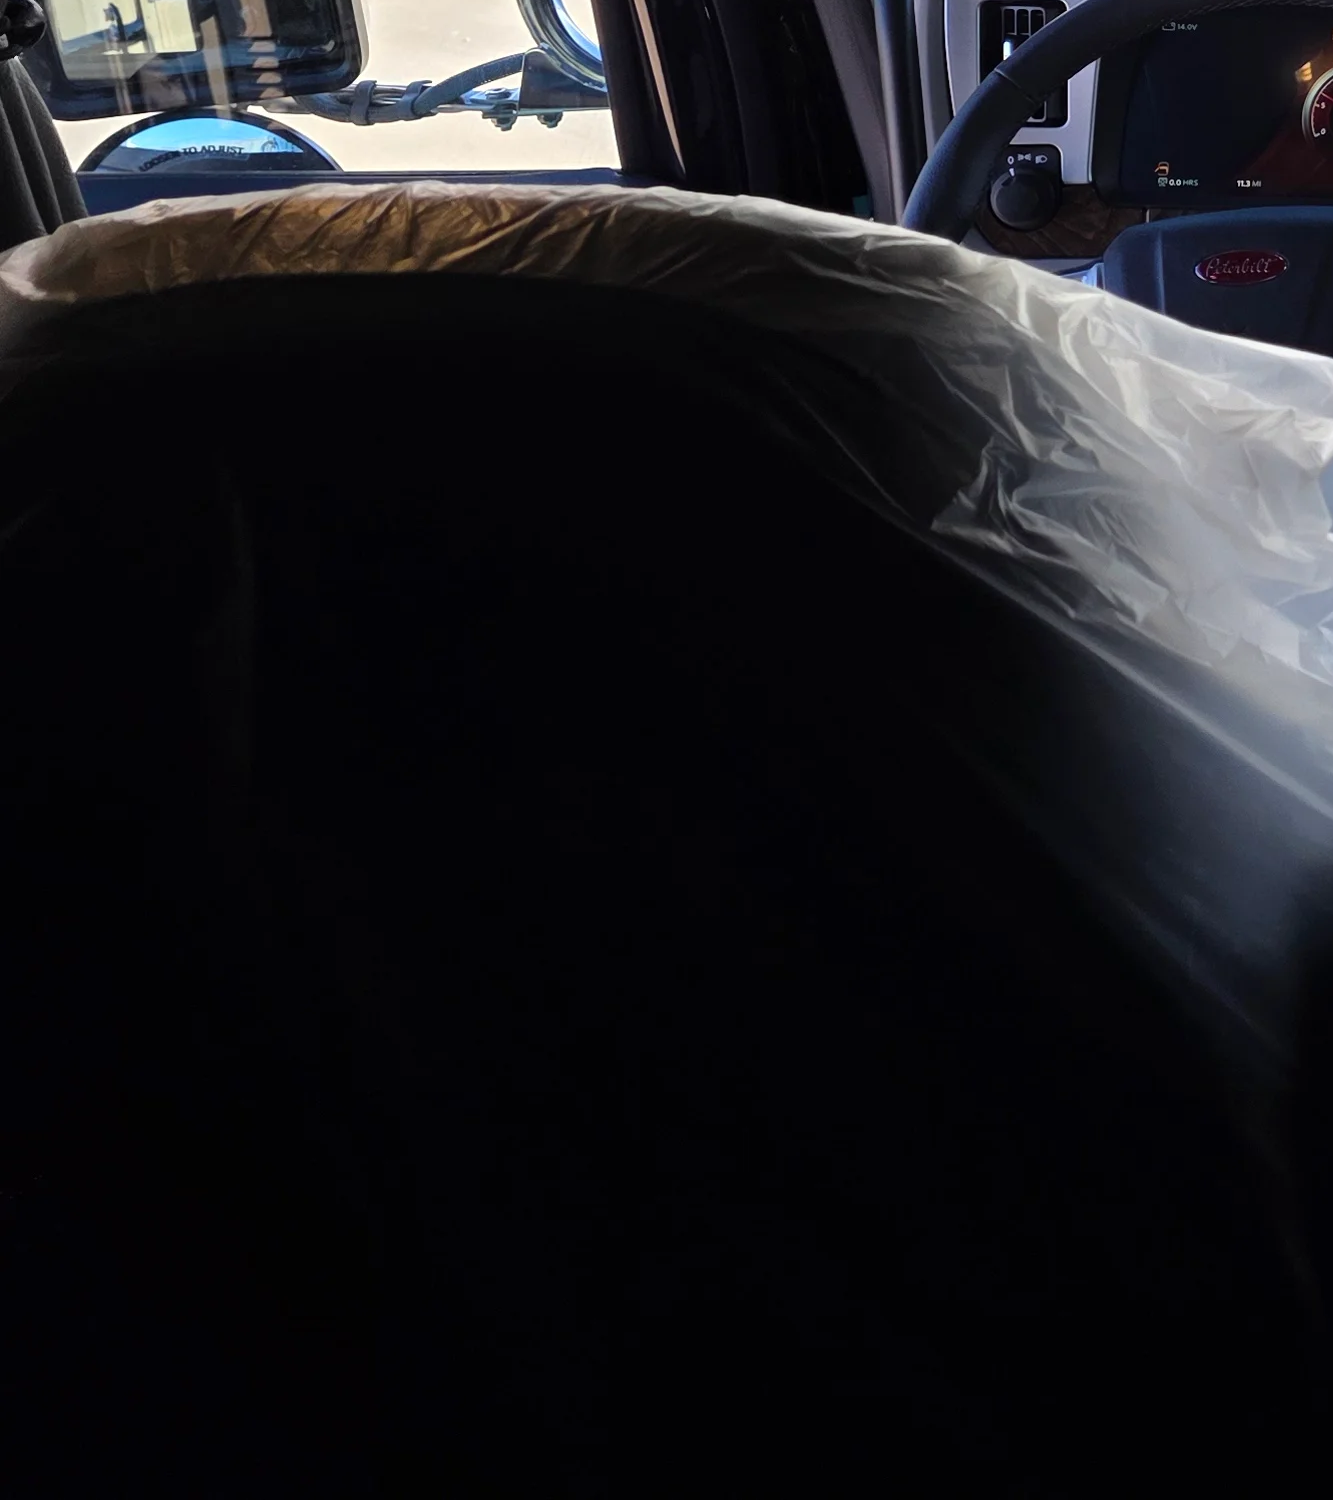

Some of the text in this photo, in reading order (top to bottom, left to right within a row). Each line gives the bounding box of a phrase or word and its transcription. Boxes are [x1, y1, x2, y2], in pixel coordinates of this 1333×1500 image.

[182, 146, 197, 155] TO
[201, 145, 244, 156] ADJUST
[1182, 179, 1198, 187] HRS
[1205, 257, 1278, 278] Peterbilt
